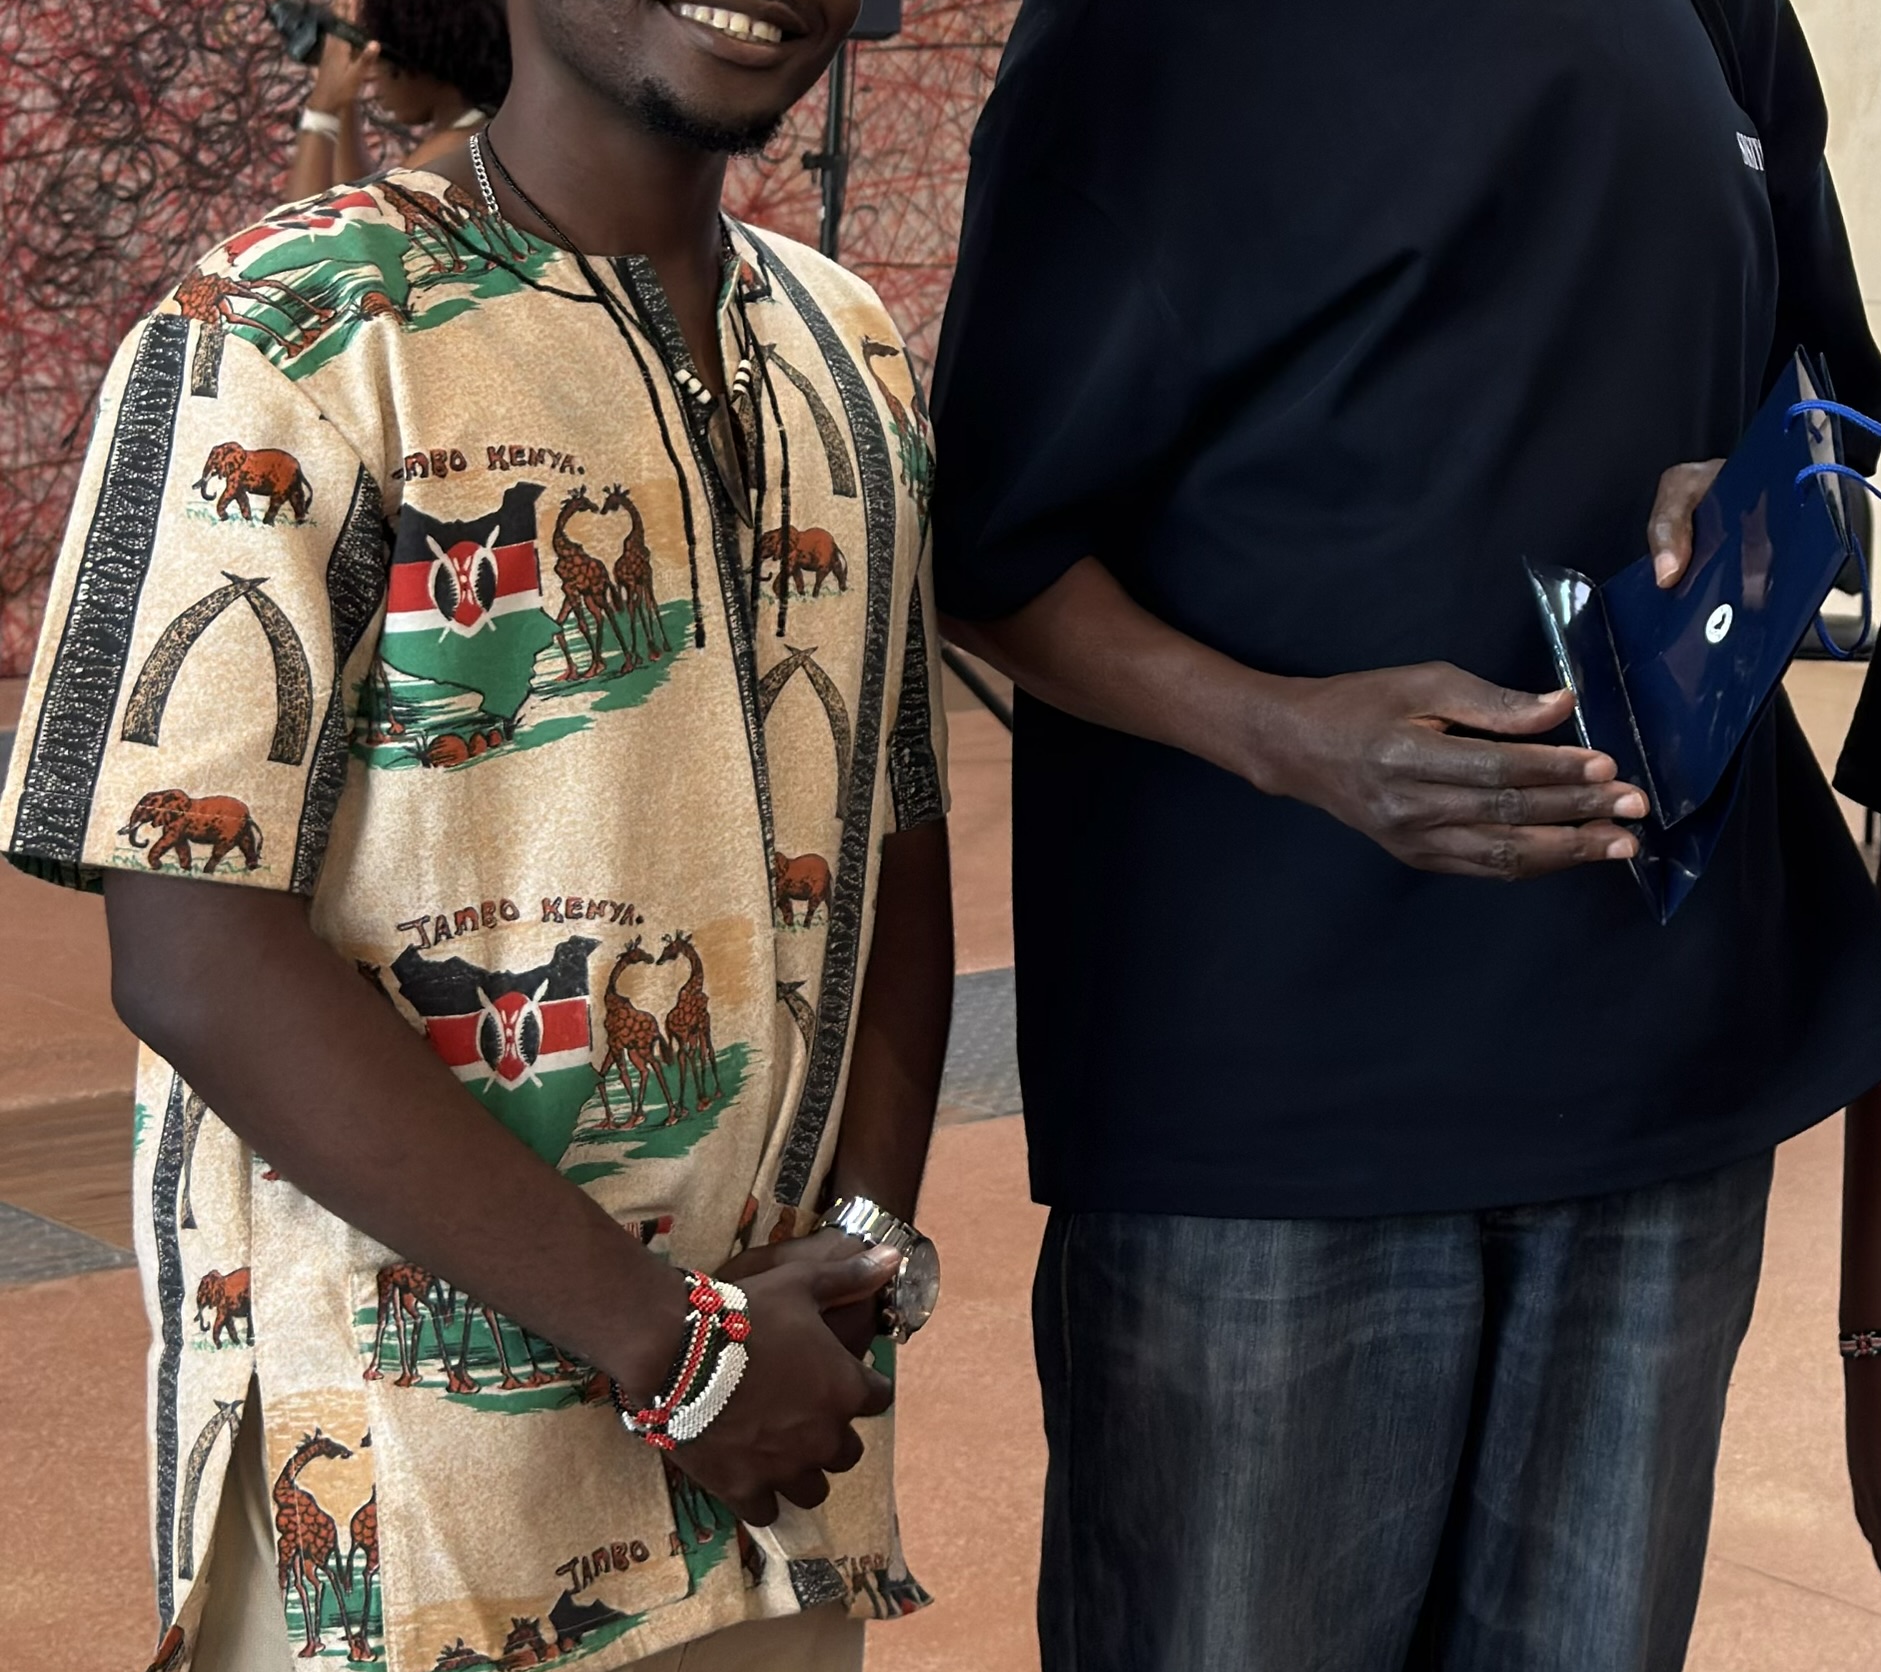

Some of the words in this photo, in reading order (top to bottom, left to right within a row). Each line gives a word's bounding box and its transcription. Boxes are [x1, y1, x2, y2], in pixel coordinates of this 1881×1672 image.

[392, 448, 468, 482] MBO
[396, 897, 520, 949] JAMBO
[555, 1539, 650, 1595] JAMBO
